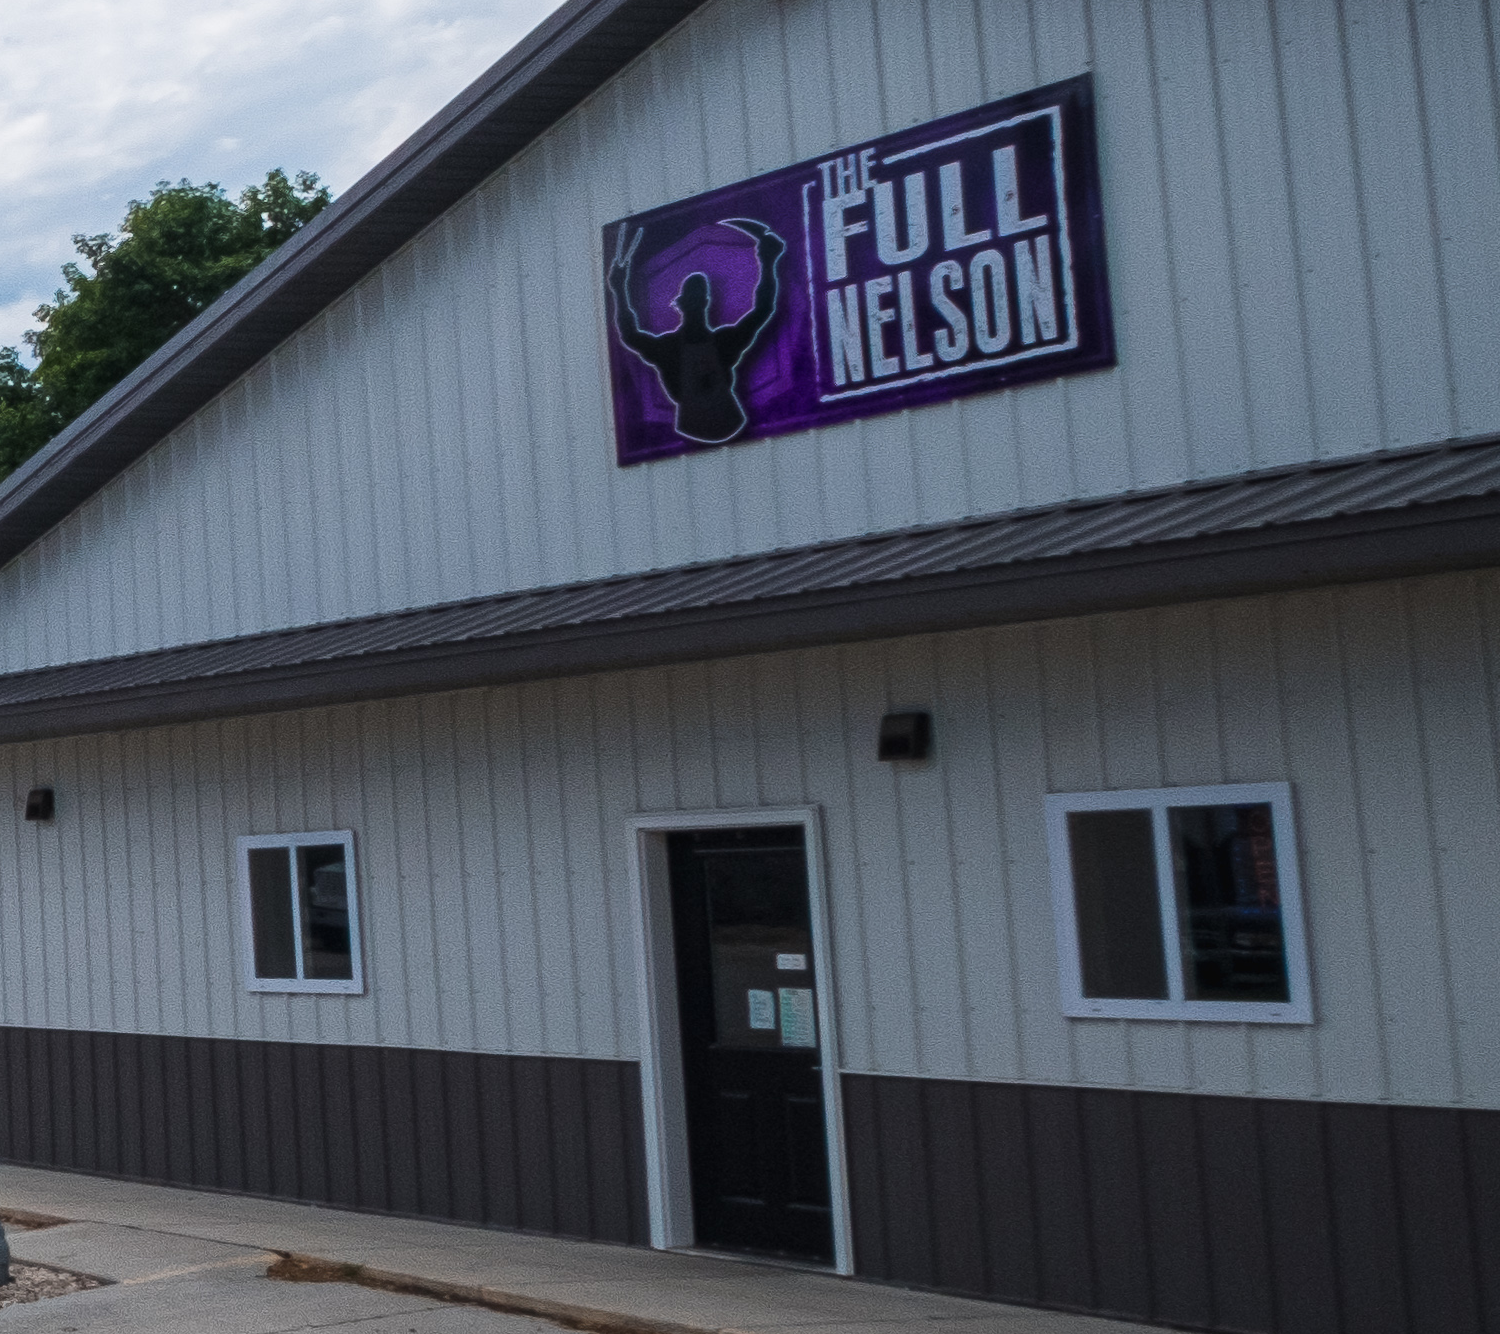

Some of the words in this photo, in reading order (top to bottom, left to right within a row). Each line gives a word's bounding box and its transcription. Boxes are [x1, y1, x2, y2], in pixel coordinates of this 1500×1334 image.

[817, 148, 877, 199] THE
[822, 145, 1048, 282] FULL
[826, 234, 1058, 386] NELSON
